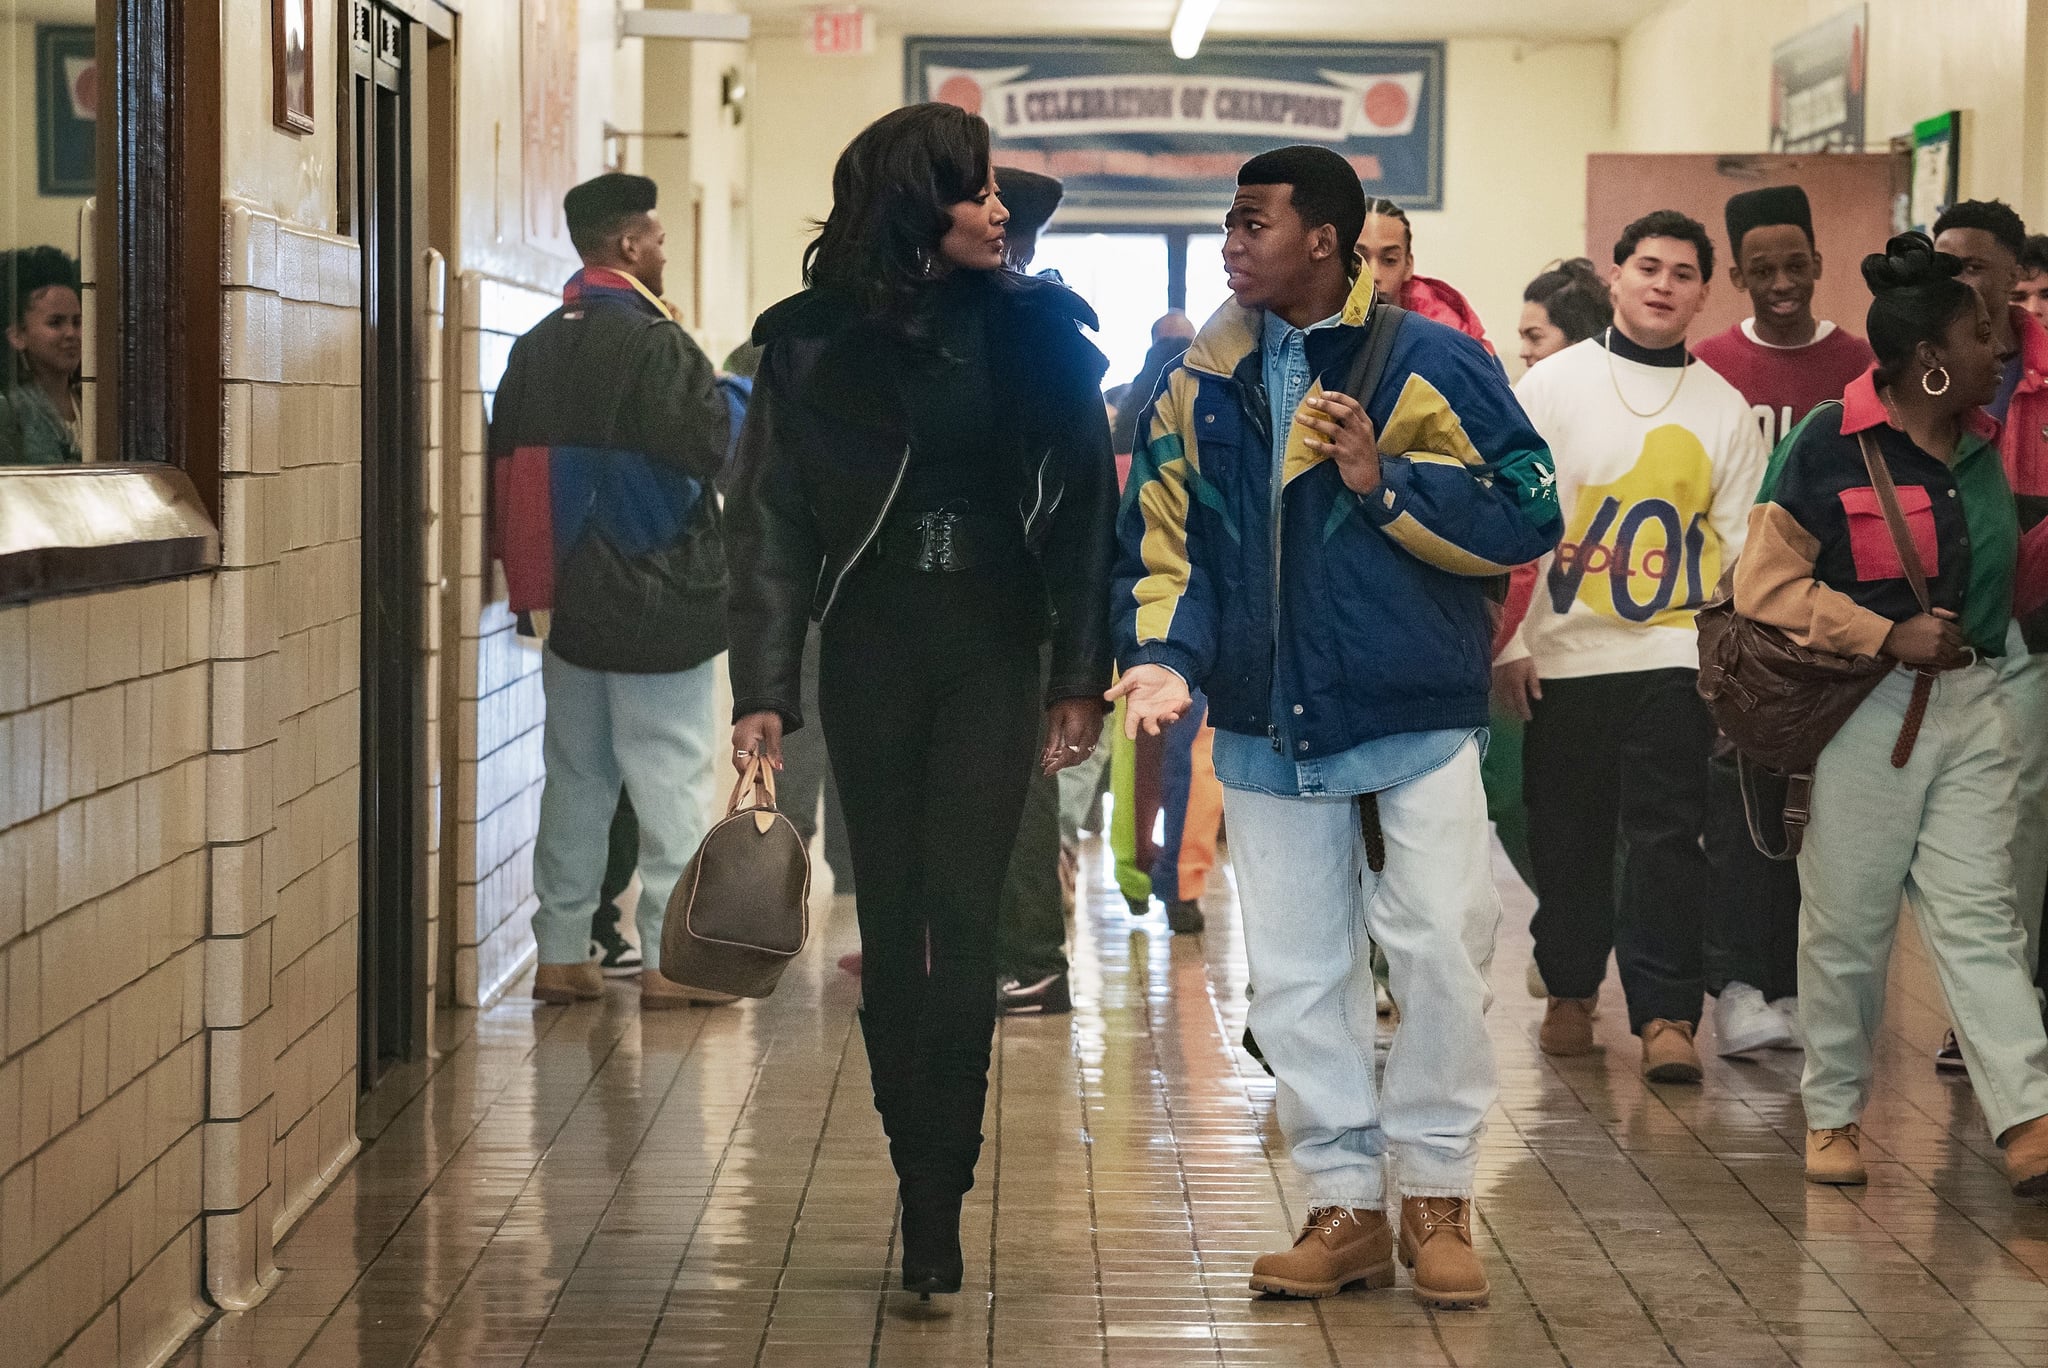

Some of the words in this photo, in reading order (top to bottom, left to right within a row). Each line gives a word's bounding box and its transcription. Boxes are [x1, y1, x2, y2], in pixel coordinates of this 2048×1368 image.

[815, 13, 862, 51] EXIT
[1005, 92, 1020, 126] A
[1025, 86, 1174, 123] CELEBRATION
[1180, 86, 1208, 119] OF
[1213, 86, 1344, 130] CHAMPIONS
[1557, 543, 1669, 579] POLO
